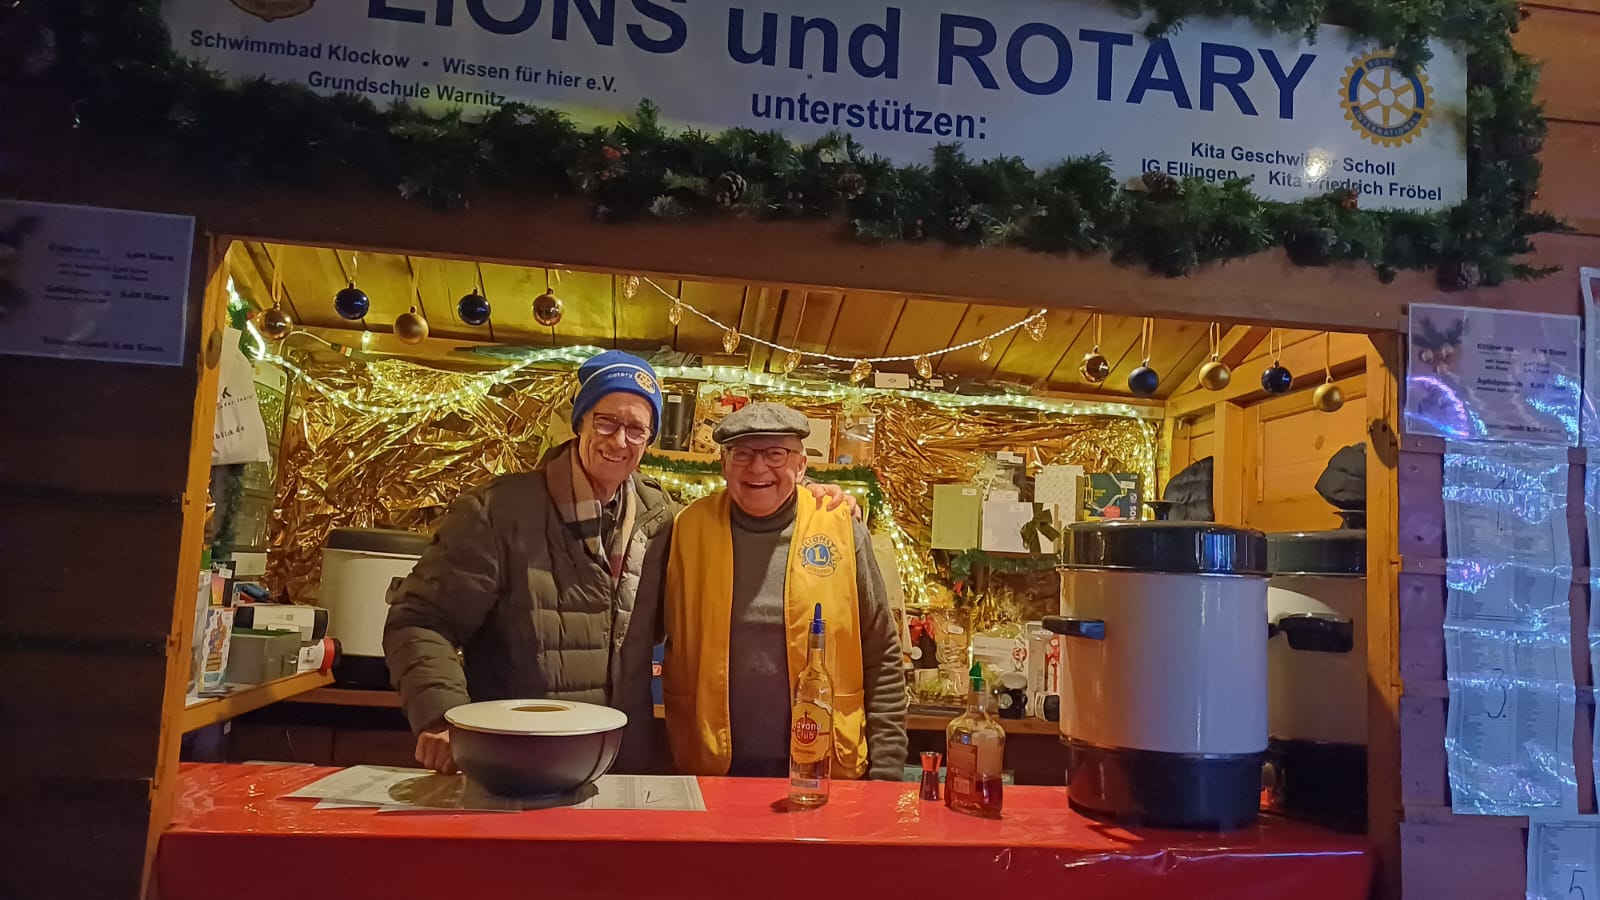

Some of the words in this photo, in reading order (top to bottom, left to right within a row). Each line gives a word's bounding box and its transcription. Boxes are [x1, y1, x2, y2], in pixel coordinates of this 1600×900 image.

[189, 29, 322, 59] Schwimmbad
[328, 44, 410, 69] Klockow
[442, 57, 509, 80] Wissen
[515, 65, 542, 84] für
[546, 69, 582, 88] hier
[586, 75, 617, 93] e.V.
[368, 0, 688, 54] ONS
[727, 6, 901, 80] und
[937, 12, 1317, 120] ROTARY
[308, 71, 431, 99] Grundschule
[436, 84, 506, 107] Warnitz
[751, 92, 988, 140] unterstützen:
[1141, 158, 1161, 173] IG
[1167, 161, 1237, 183] Ellingen
[1269, 170, 1303, 188] Kita
[1389, 182, 1442, 201] Fröbel
[1191, 142, 1225, 160] Kita
[1343, 157, 1396, 177] Scholl
[804, 535, 832, 547] LIONS
